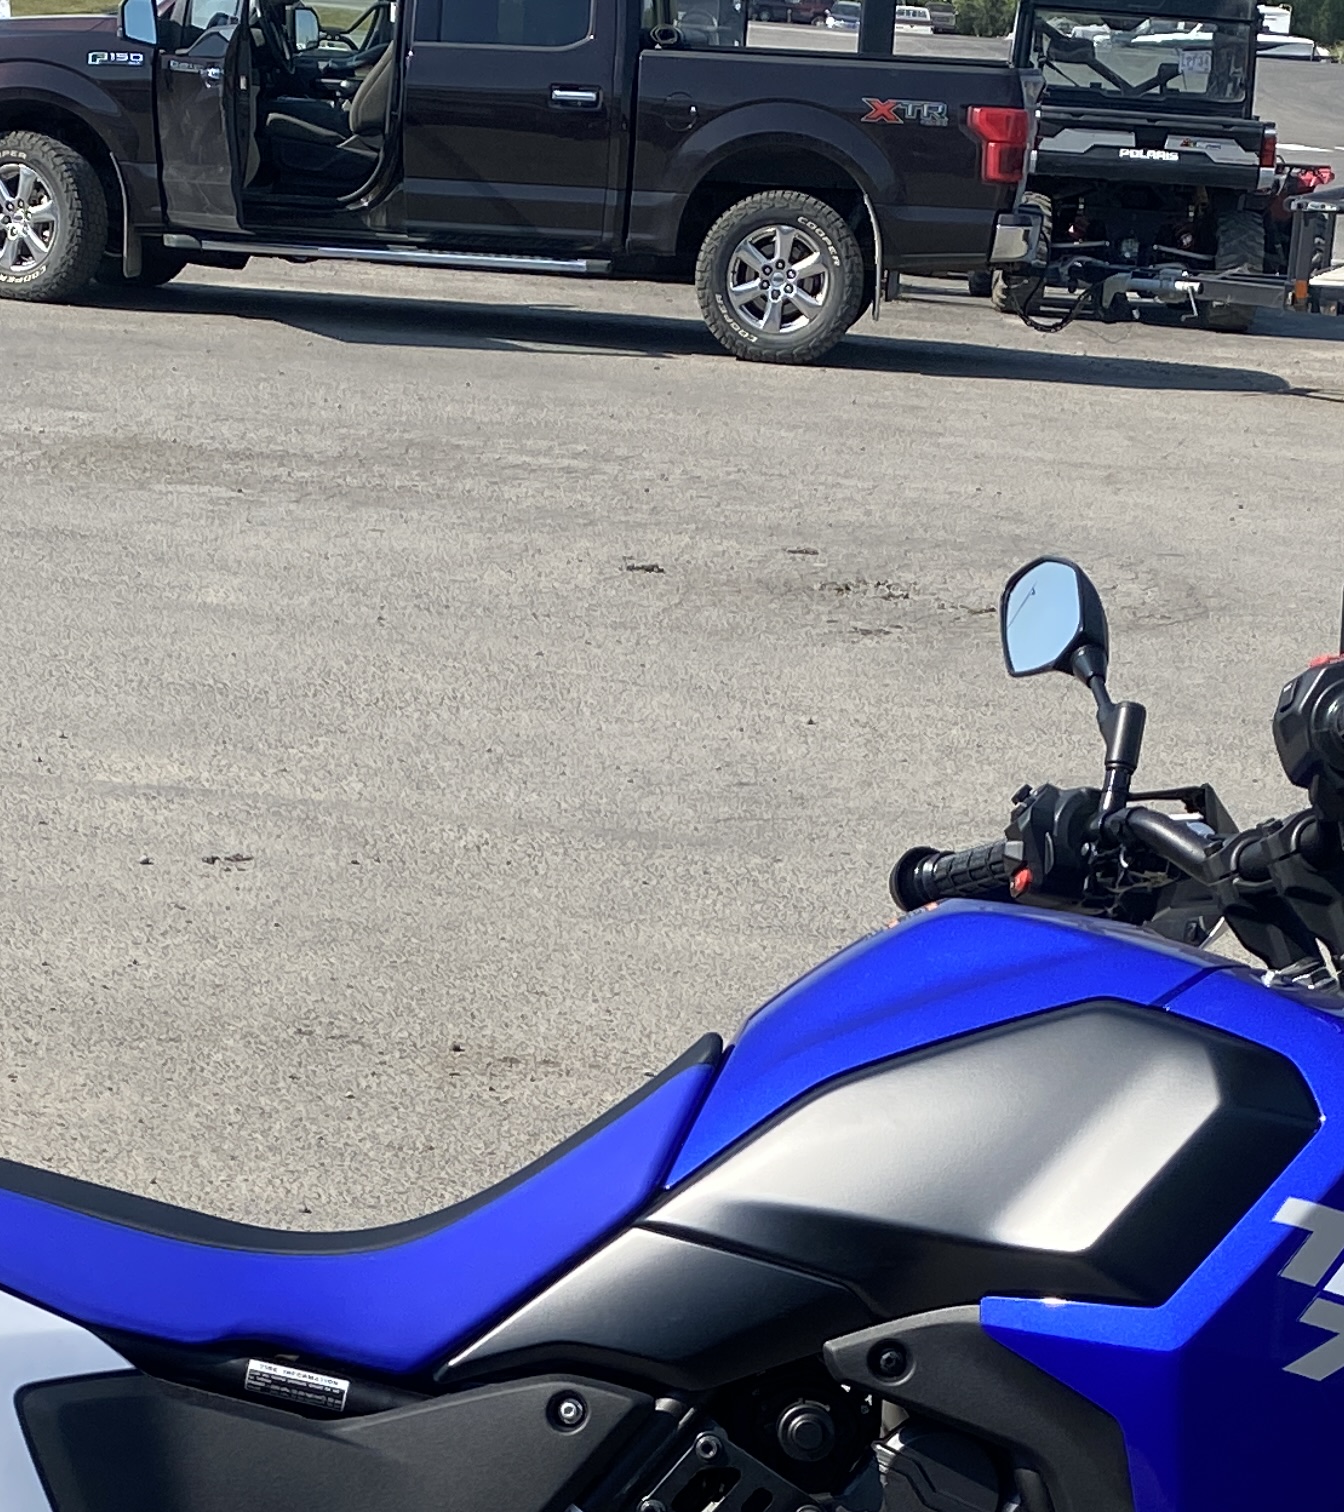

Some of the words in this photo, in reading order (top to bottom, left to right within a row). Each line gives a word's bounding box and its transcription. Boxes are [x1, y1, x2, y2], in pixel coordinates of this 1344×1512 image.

[860, 97, 949, 125] XTR
[1118, 148, 1180, 161] POLARIS
[796, 215, 842, 267] COOPER
[714, 293, 759, 343] COOPER
